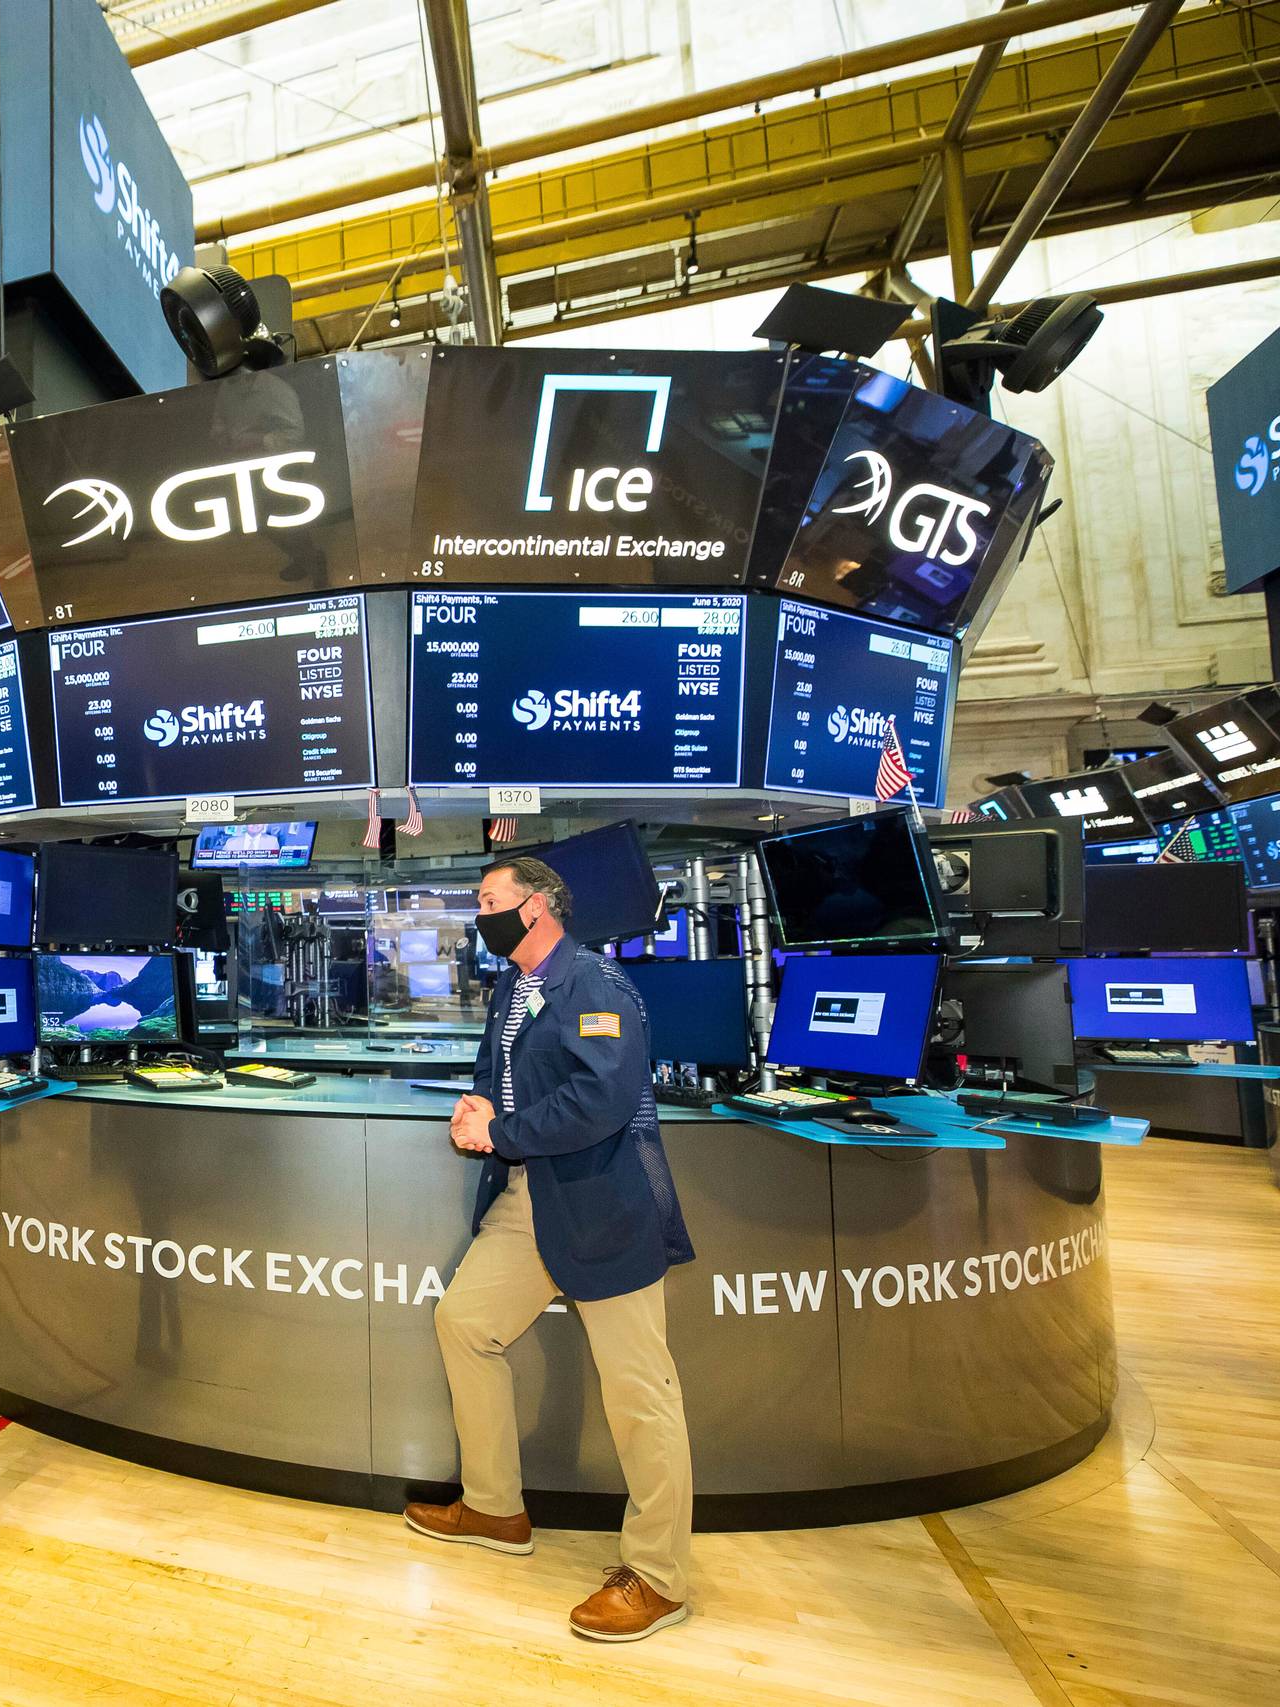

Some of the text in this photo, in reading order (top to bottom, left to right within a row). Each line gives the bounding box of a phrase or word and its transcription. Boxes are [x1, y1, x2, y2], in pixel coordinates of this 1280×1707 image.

[117, 220, 160, 300] PAYME
[151, 451, 325, 542] GTS
[889, 483, 991, 566] GTS
[433, 534, 725, 561] Intercontinental Exchange
[421, 561, 444, 577] 8S
[788, 571, 805, 588] 8R
[308, 598, 358, 611] June 5, 2020
[416, 595, 498, 605] Shift4 Payments, Inc.
[692, 598, 741, 607] June 5, 2020
[55, 604, 73, 619] 8T
[426, 606, 476, 624] FOUR
[622, 611, 739, 624] 26.00 28.00
[238, 612, 357, 637] 26.00 28.00
[786, 614, 816, 636] FOUR
[52, 628, 122, 642] Shift4 Payments, Inc.
[62, 640, 105, 659] FOUR
[296, 646, 342, 662] FOUR
[426, 642, 479, 653] 15,000,000
[678, 644, 722, 657] FOUR
[784, 649, 815, 664] 15,000,000
[300, 667, 342, 680] LISTED
[679, 664, 720, 676] LISTED
[64, 672, 110, 685] 15,000,000
[452, 672, 478, 683] 23.00
[916, 676, 938, 692] FOUR
[301, 684, 343, 700] NYSE
[678, 682, 718, 695] NYSE
[796, 681, 812, 693] 23.00
[88, 700, 112, 710] 23.00
[456, 703, 478, 713] 0.00
[554, 690, 641, 718] Shift4
[915, 696, 936, 708] LISTED
[181, 700, 265, 732] Shift4
[914, 711, 934, 724] NYSE
[95, 727, 113, 736] 0.00
[553, 720, 640, 732] PAYMENTS
[182, 729, 266, 746] PAYMENTS
[456, 733, 477, 743] 0.00
[848, 736, 884, 749] PAYMEN
[97, 754, 115, 764] 0.00
[455, 762, 476, 773] 0.00
[98, 780, 117, 790] 0.00
[498, 790, 532, 802] 1370
[192, 800, 228, 812] 2080
[42, 1018, 60, 1026] 9:52
[2, 1211, 96, 1266] YORK
[104, 1232, 255, 1289] STOCK
[266, 1252, 462, 1306] EXCHA
[713, 1222, 1102, 1315] NEW YORK STOCK EXCH
